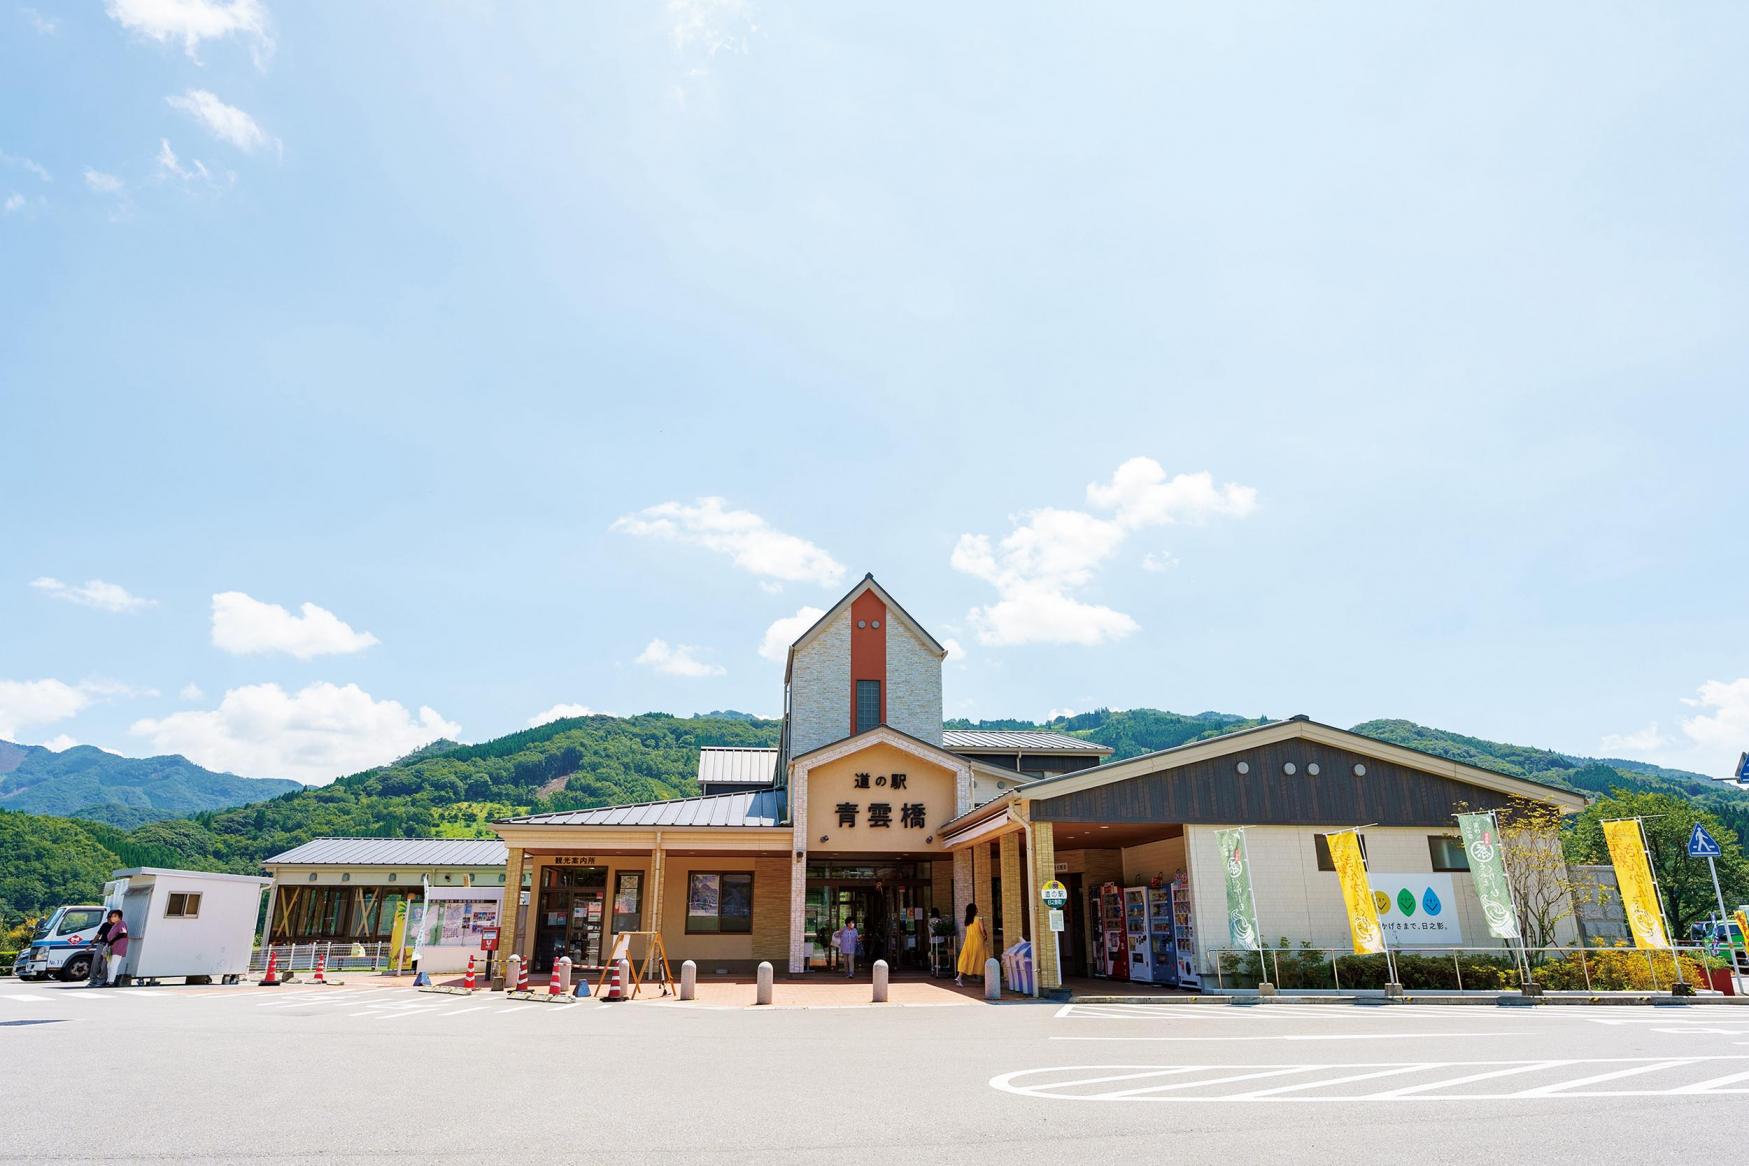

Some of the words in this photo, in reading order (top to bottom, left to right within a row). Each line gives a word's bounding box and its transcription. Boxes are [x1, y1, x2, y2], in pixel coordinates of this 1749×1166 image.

[854, 772, 907, 790] 道の駅
[835, 802, 926, 829] 青雲橋
[555, 856, 596, 865] 観光案内所
[1379, 922, 1448, 930] かげさまで、日之影。
